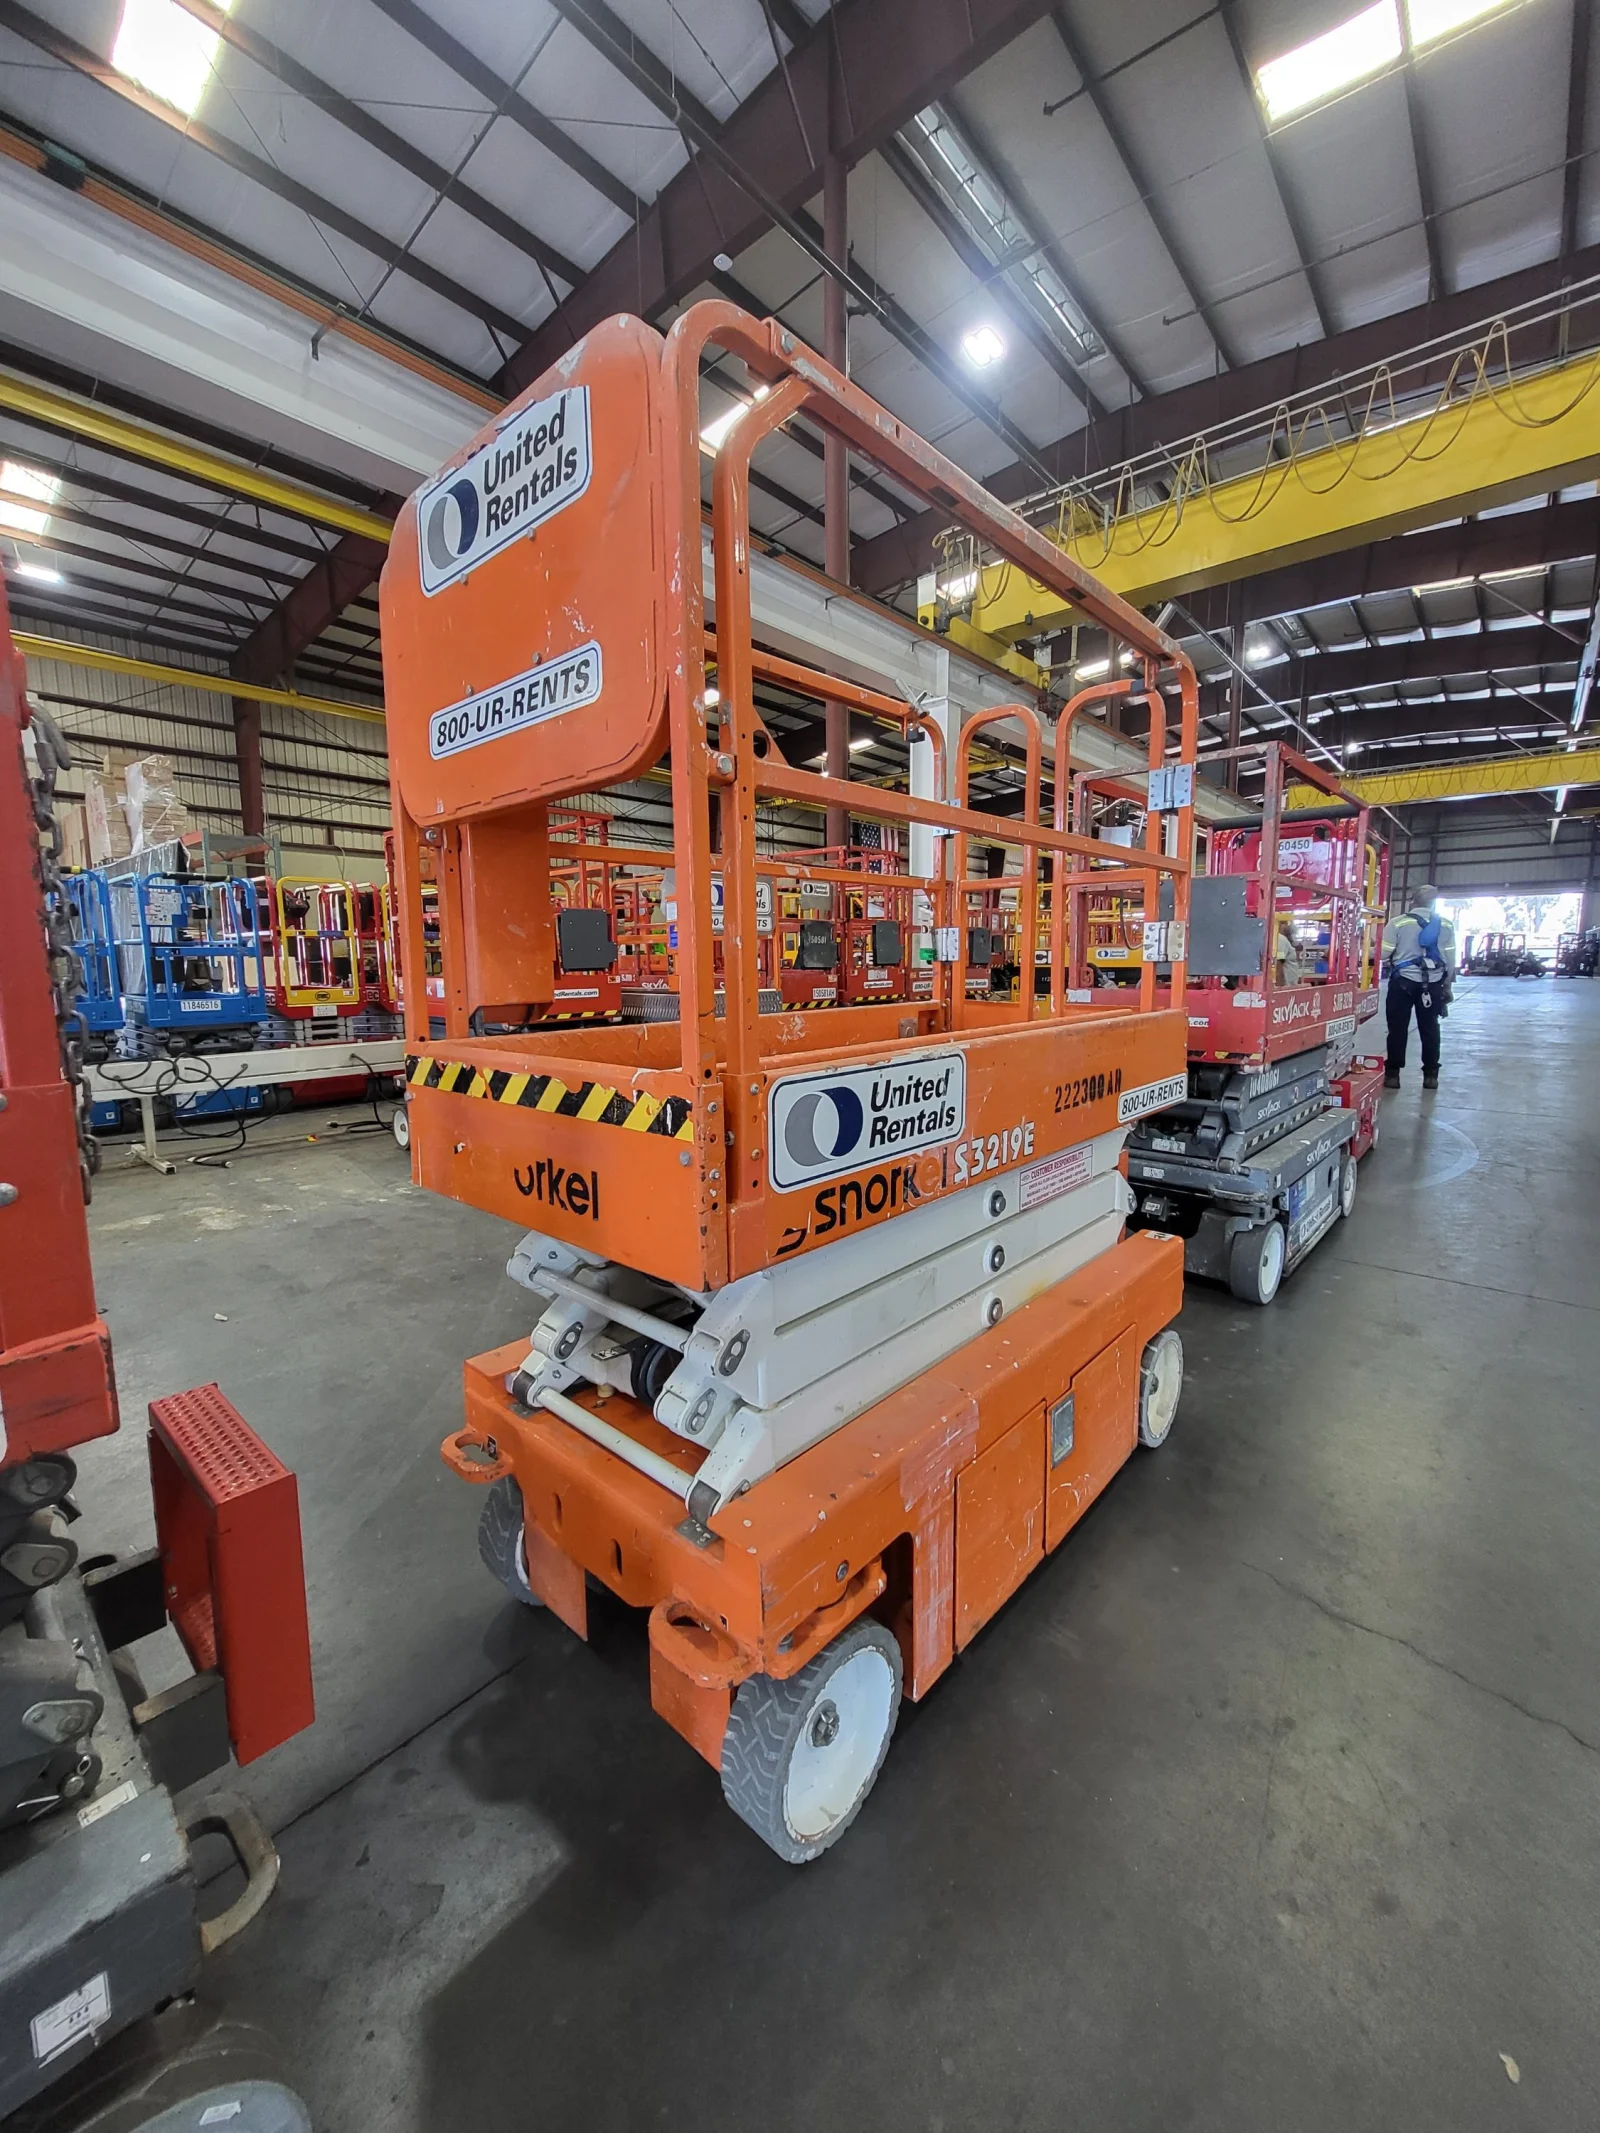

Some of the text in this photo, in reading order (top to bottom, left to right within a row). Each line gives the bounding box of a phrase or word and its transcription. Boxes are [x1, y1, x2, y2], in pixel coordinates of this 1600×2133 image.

[483, 395, 566, 495] United
[486, 444, 578, 538] Rentals
[437, 658, 591, 748] 800-UR-RENTS
[182, 1000, 219, 1010] 11846516
[1272, 996, 1310, 1024] SKYJACK
[870, 1067, 950, 1113] United
[1055, 1073, 1104, 1114] 222300
[1122, 1080, 1184, 1116] 800-UR-RENTS
[1258, 1099, 1281, 1120] SKYJACK
[869, 1100, 956, 1149] Rentals
[954, 1120, 1035, 1184] S3219E
[1030, 1151, 1084, 1179] CUSTOMER RESPONSIBILITY
[1306, 1138, 1332, 1166] SKYJACK
